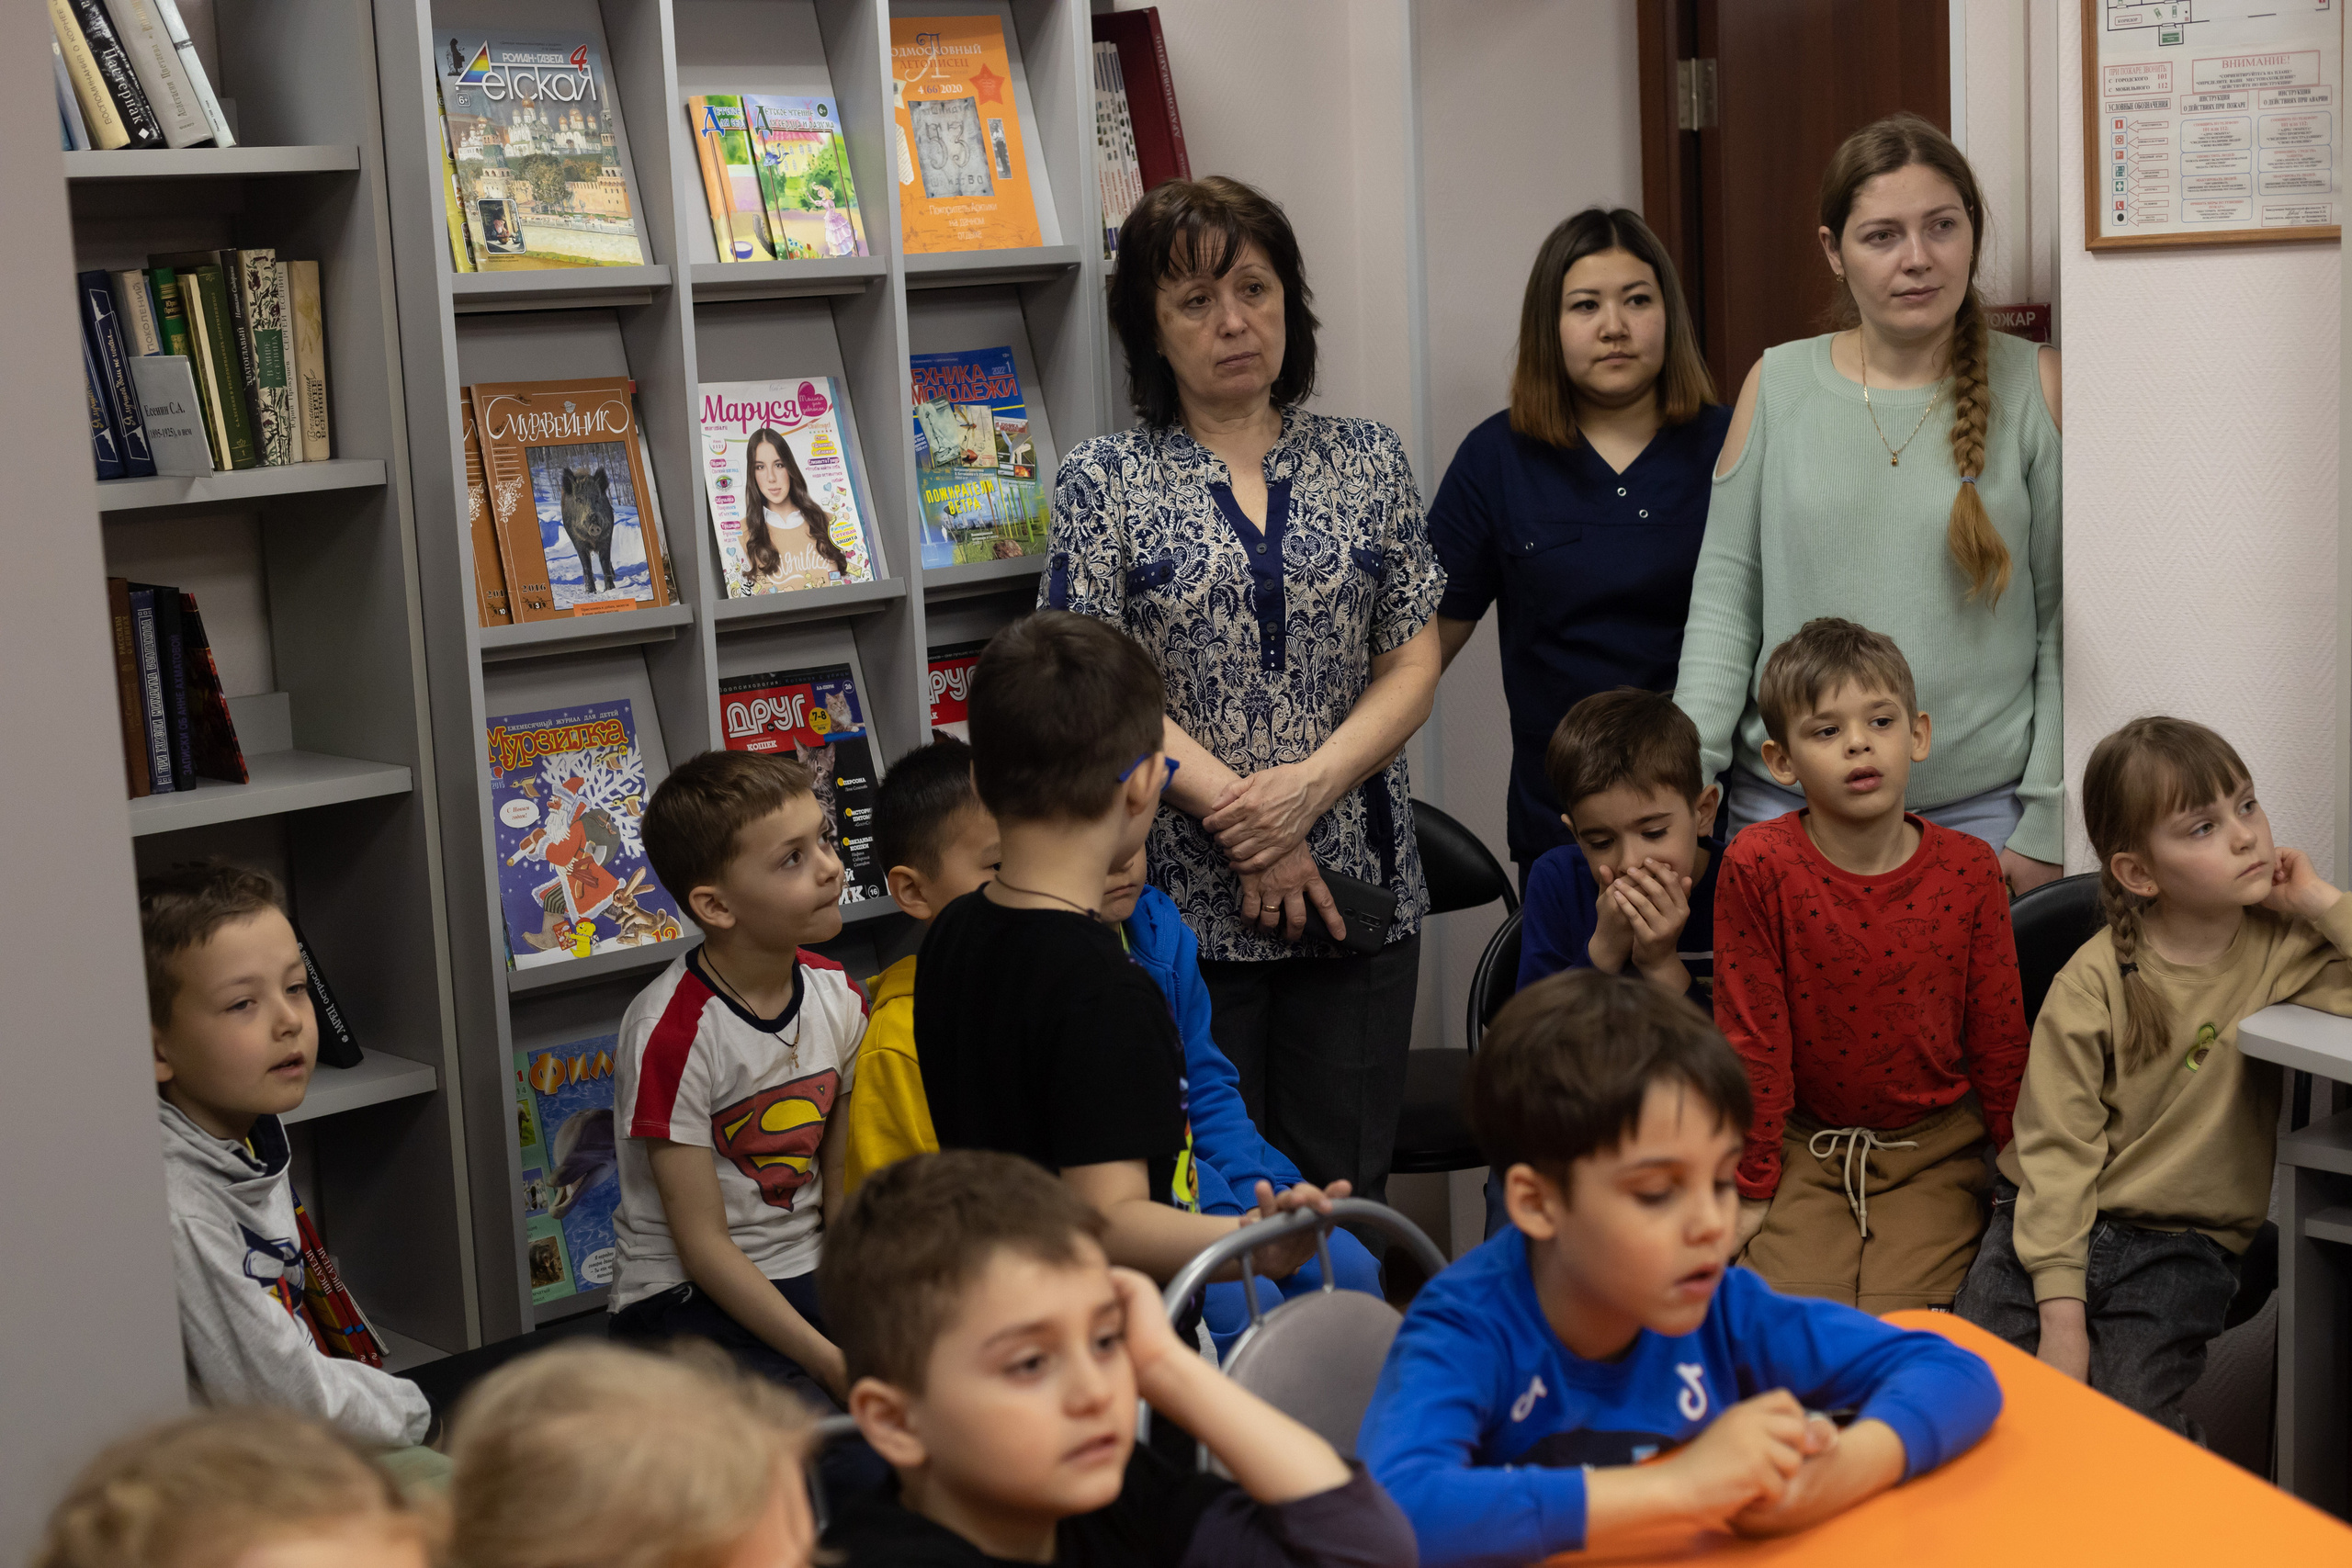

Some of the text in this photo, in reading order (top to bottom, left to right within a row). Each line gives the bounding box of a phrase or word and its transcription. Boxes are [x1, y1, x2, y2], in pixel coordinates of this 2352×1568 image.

[57, 8, 76, 42] КОРНЕЕ
[150, 43, 171, 79] Цветаева
[503, 44, 588, 72] РОМАН-ГАЗЕТА 4
[890, 44, 982, 57] ОДМОСКОВНЫЙ
[2222, 55, 2290, 69] ВНИМАНИЕ!
[455, 39, 597, 102] Детская
[2120, 67, 2142, 75] ПОЖАРЕ
[2143, 65, 2167, 73] ЗВОНИТЬ
[76, 53, 112, 125] ВОСПОМИНАНИЯ
[102, 48, 143, 125] Пастернак
[168, 81, 187, 118] Анастасия
[2109, 100, 2168, 111] УСЛОВНЫЕ ОБОЗНАЧЕНИЯ
[132, 282, 155, 352] ПОКОЛЕНИЙ
[237, 327, 253, 386] ЗЛАТОГЛАВЫЙ
[911, 364, 987, 386] ЕХНИКА
[143, 402, 186, 417] Есенин С.А.
[700, 394, 802, 434] Маруся
[182, 429, 192, 437] нем
[926, 479, 995, 504] ПОЖИРАТЕЛИ
[948, 496, 982, 515] ВЕТРА
[831, 529, 857, 538] Сетевая
[836, 536, 858, 545] защита
[486, 590, 506, 598] 201
[521, 583, 547, 593] 2016
[114, 616, 124, 655] РАССКАЗЫ
[141, 618, 169, 774] ТРИ ЖИЗНИ МИХАИЛА БУЛГАКОВА
[169, 635, 193, 775] ЗАПИСКИ ОБ АННЕ АХМАТОВОЙ
[507, 720, 553, 732] ЕЖЕМЕСЯЧНЫЙ
[556, 716, 581, 725] ЖУРНАЛ
[599, 710, 619, 719] ДЕТЕЙ
[726, 694, 806, 739] ДРУГ
[812, 711, 827, 722] 7-8
[486, 719, 628, 771] Мурзилка
[746, 740, 778, 751] КОШЕК
[305, 1249, 332, 1295] ПИСАТЕЛИ
[317, 1247, 345, 1293] ПИСАТЕЛИ
